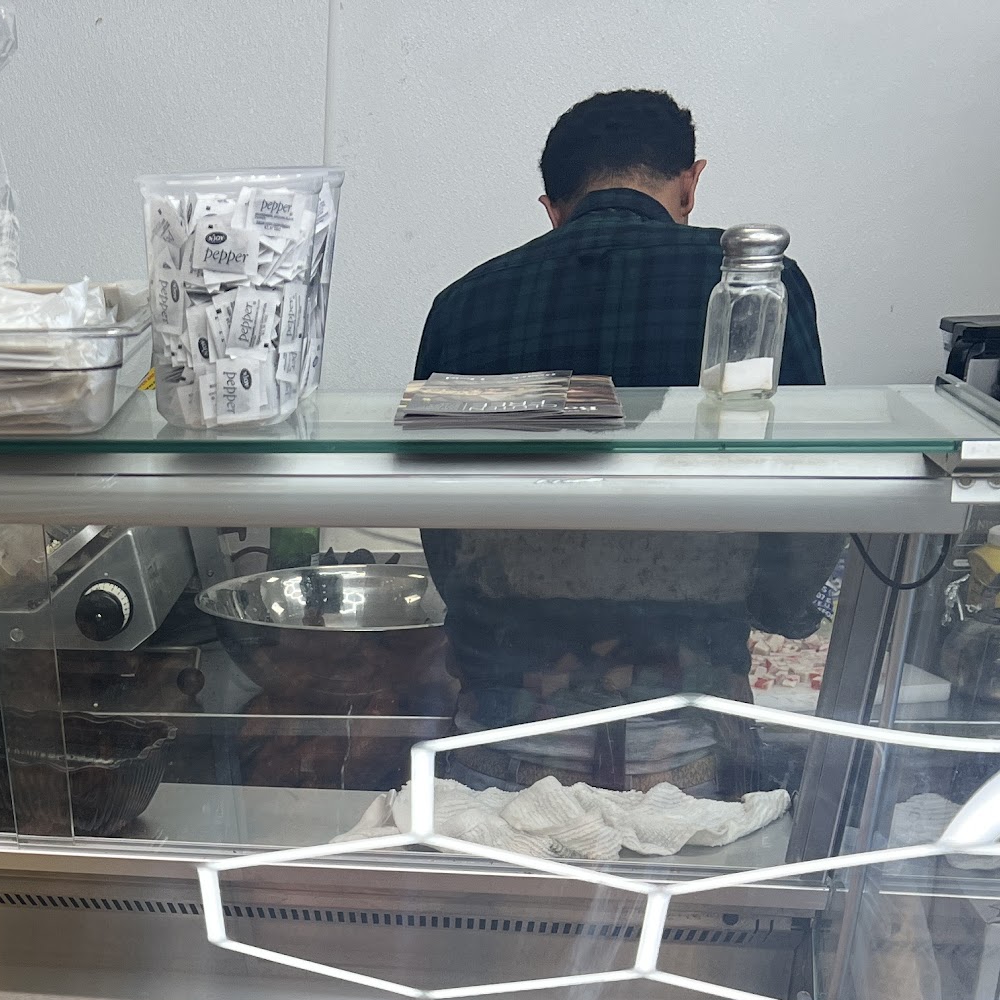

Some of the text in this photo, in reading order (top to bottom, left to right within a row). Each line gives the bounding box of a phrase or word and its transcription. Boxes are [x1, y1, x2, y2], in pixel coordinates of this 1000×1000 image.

[260, 199, 292, 214] pepper
[203, 247, 249, 265] pepper
[158, 279, 169, 324] pepper
[238, 302, 253, 342] pepper
[223, 371, 237, 414] pepper
